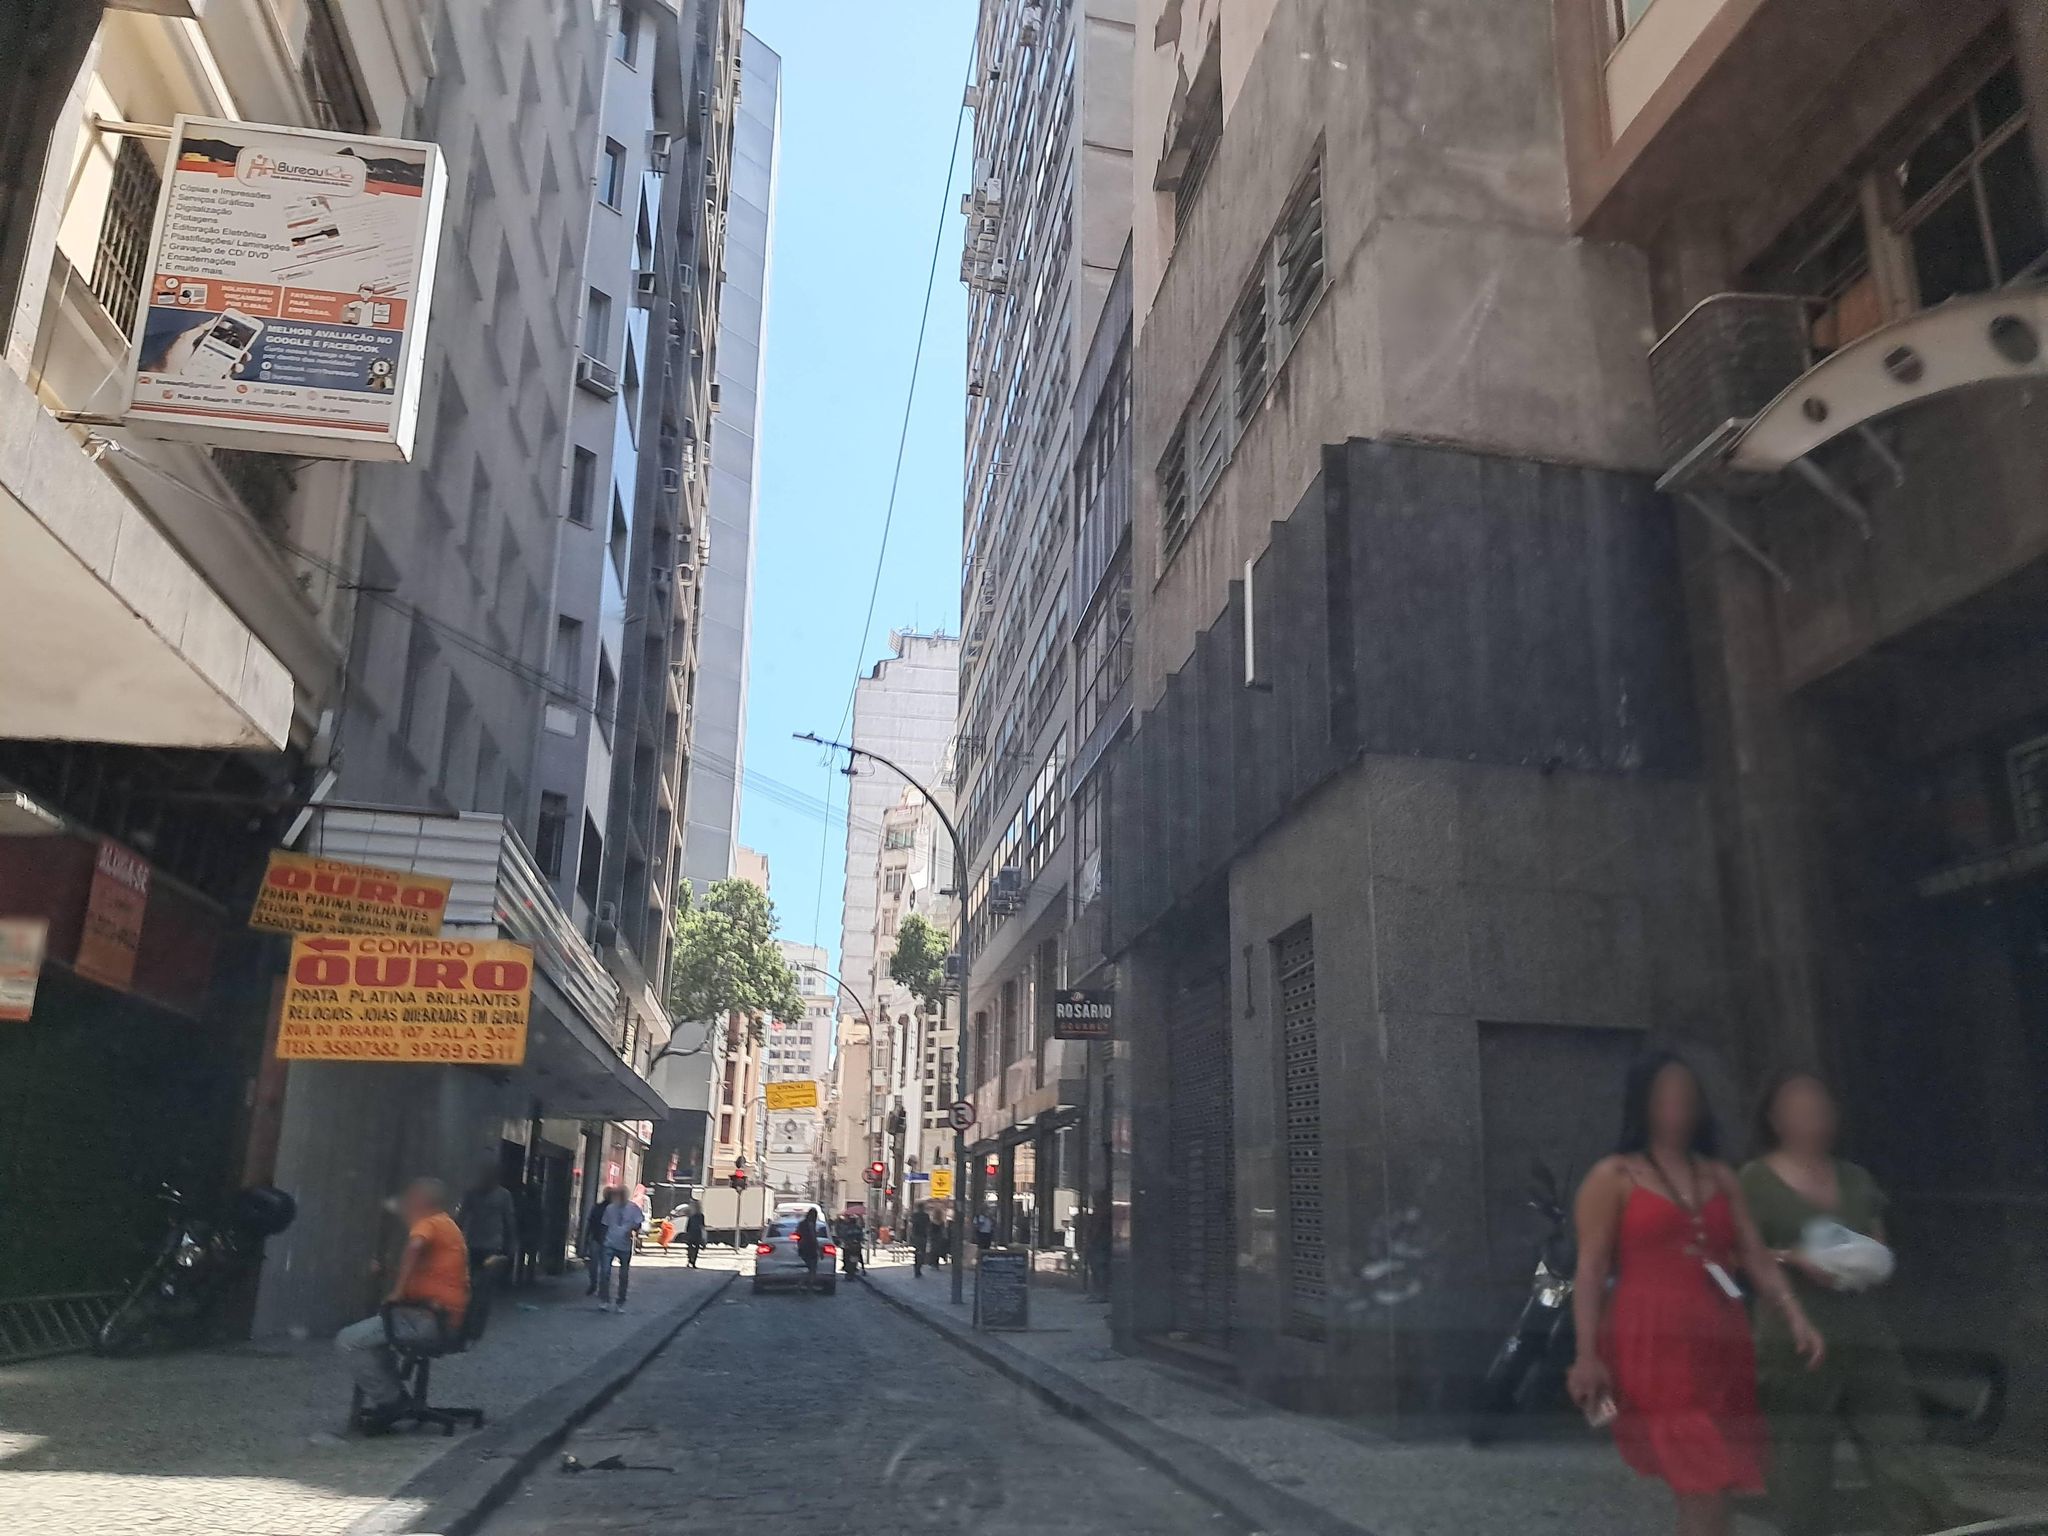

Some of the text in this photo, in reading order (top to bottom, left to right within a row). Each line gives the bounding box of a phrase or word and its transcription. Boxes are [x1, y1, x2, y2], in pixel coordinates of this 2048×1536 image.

[277, 162, 323, 176] Bureau
[220, 188, 272, 199] Impressões
[175, 203, 232, 215] Digitalização
[174, 213, 218, 223] Plotagens
[172, 223, 267, 239] Editoração Eletrônica
[169, 242, 212, 254] Gravação
[214, 247, 225, 255] de
[248, 250, 269, 259] DVD
[165, 262, 172, 270] E
[174, 264, 199, 273] muito
[267, 325, 393, 344] MELHOR AVALIAÇÃO NO
[265, 336, 311, 347] GOOGLE
[322, 341, 380, 353] FACEBOOK
[314, 861, 400, 881] COMPRO
[268, 865, 445, 911] OURO
[305, 892, 351, 911] PLATINA
[357, 902, 430, 922] BRILHANTES
[358, 937, 474, 957] COMPRO
[295, 954, 528, 991] OURO
[291, 988, 521, 1007] PRATA PLATINA BRILHANTES
[360, 1006, 398, 1021] JOIAS
[471, 1008, 488, 1024] EM
[1056, 1000, 1112, 1019] ROSÁRIO
[285, 1023, 312, 1037] RUA
[430, 1026, 477, 1039] SALA
